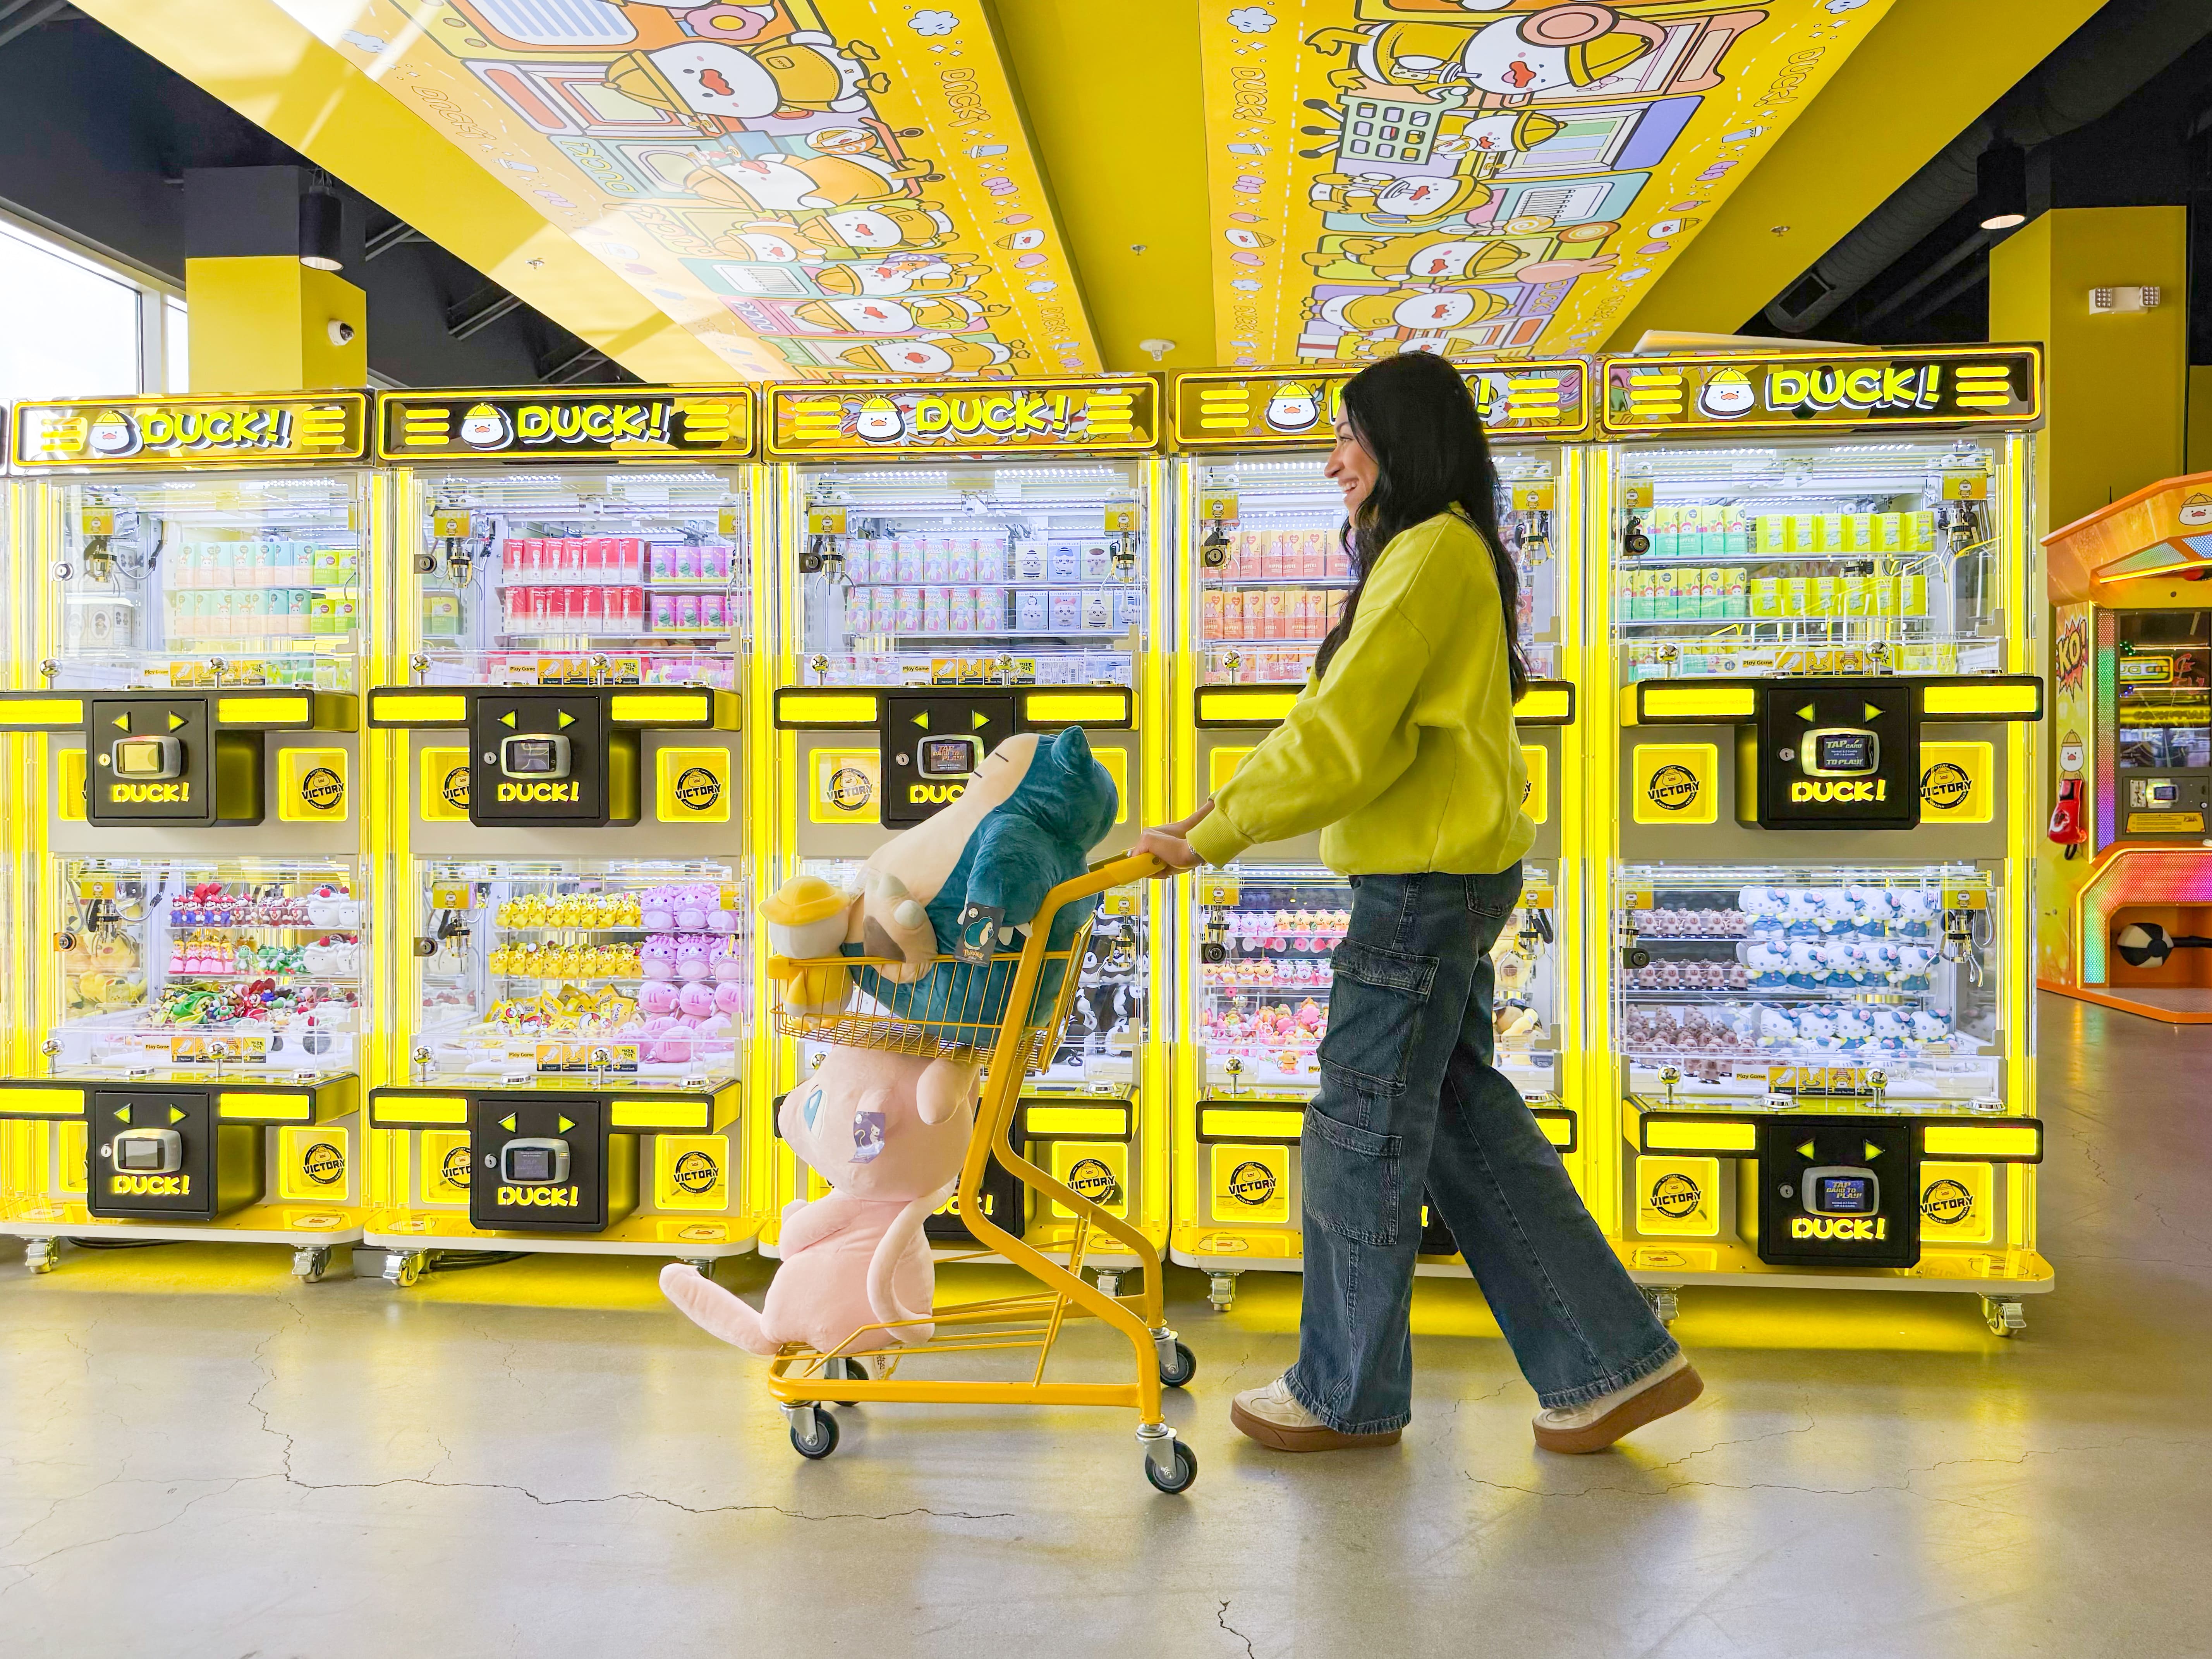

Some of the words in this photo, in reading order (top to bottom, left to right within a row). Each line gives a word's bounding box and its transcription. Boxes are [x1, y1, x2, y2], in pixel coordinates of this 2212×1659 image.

[1753, 46, 1825, 107] DUCK!
[1231, 67, 1276, 125] DUCK!
[560, 141, 639, 193] DUCK!
[730, 300, 781, 332] DUCK!
[1233, 304, 1263, 334] DUCK!
[1768, 365, 1941, 407] DUCK!
[518, 403, 665, 440] DUCK!
[917, 395, 1069, 435] DUCK!
[143, 409, 281, 445] DUCK!
[2058, 619, 2087, 679] KO!
[172, 677, 176, 686] 1
[539, 675, 544, 684] 1
[932, 675, 938, 684] 1
[1011, 675, 1018, 684] 4
[1826, 740, 1847, 749] TAP
[113, 782, 189, 803] DUCK!
[302, 783, 344, 800] VICTORY
[443, 786, 469, 800] VICT
[498, 781, 580, 803] DUCK!
[675, 783, 721, 800] VICTORY
[826, 784, 873, 800] VICTORY
[910, 785, 965, 804] DUC
[1647, 781, 1700, 800] VICTORY
[1791, 779, 1886, 802] DUCK!
[1920, 780, 1972, 798] VICTORY
[172, 1053, 177, 1062] 1
[537, 1061, 542, 1070] 1
[1770, 1083, 1775, 1093] 1
[1857, 1085, 1865, 1094] 4
[303, 1159, 345, 1175] VICTORY
[442, 1166, 471, 1178] VICTO
[673, 1168, 719, 1183] VICTORY
[114, 1175, 191, 1195] DUCK!
[1068, 1175, 1116, 1190] VICTORY
[1229, 1178, 1277, 1196] VICTORY
[498, 1186, 579, 1207] DUCK!
[1650, 1190, 1702, 1207] VICTORY
[1920, 1196, 1973, 1214] VICTORY
[1791, 1218, 1886, 1240] DUCK!
